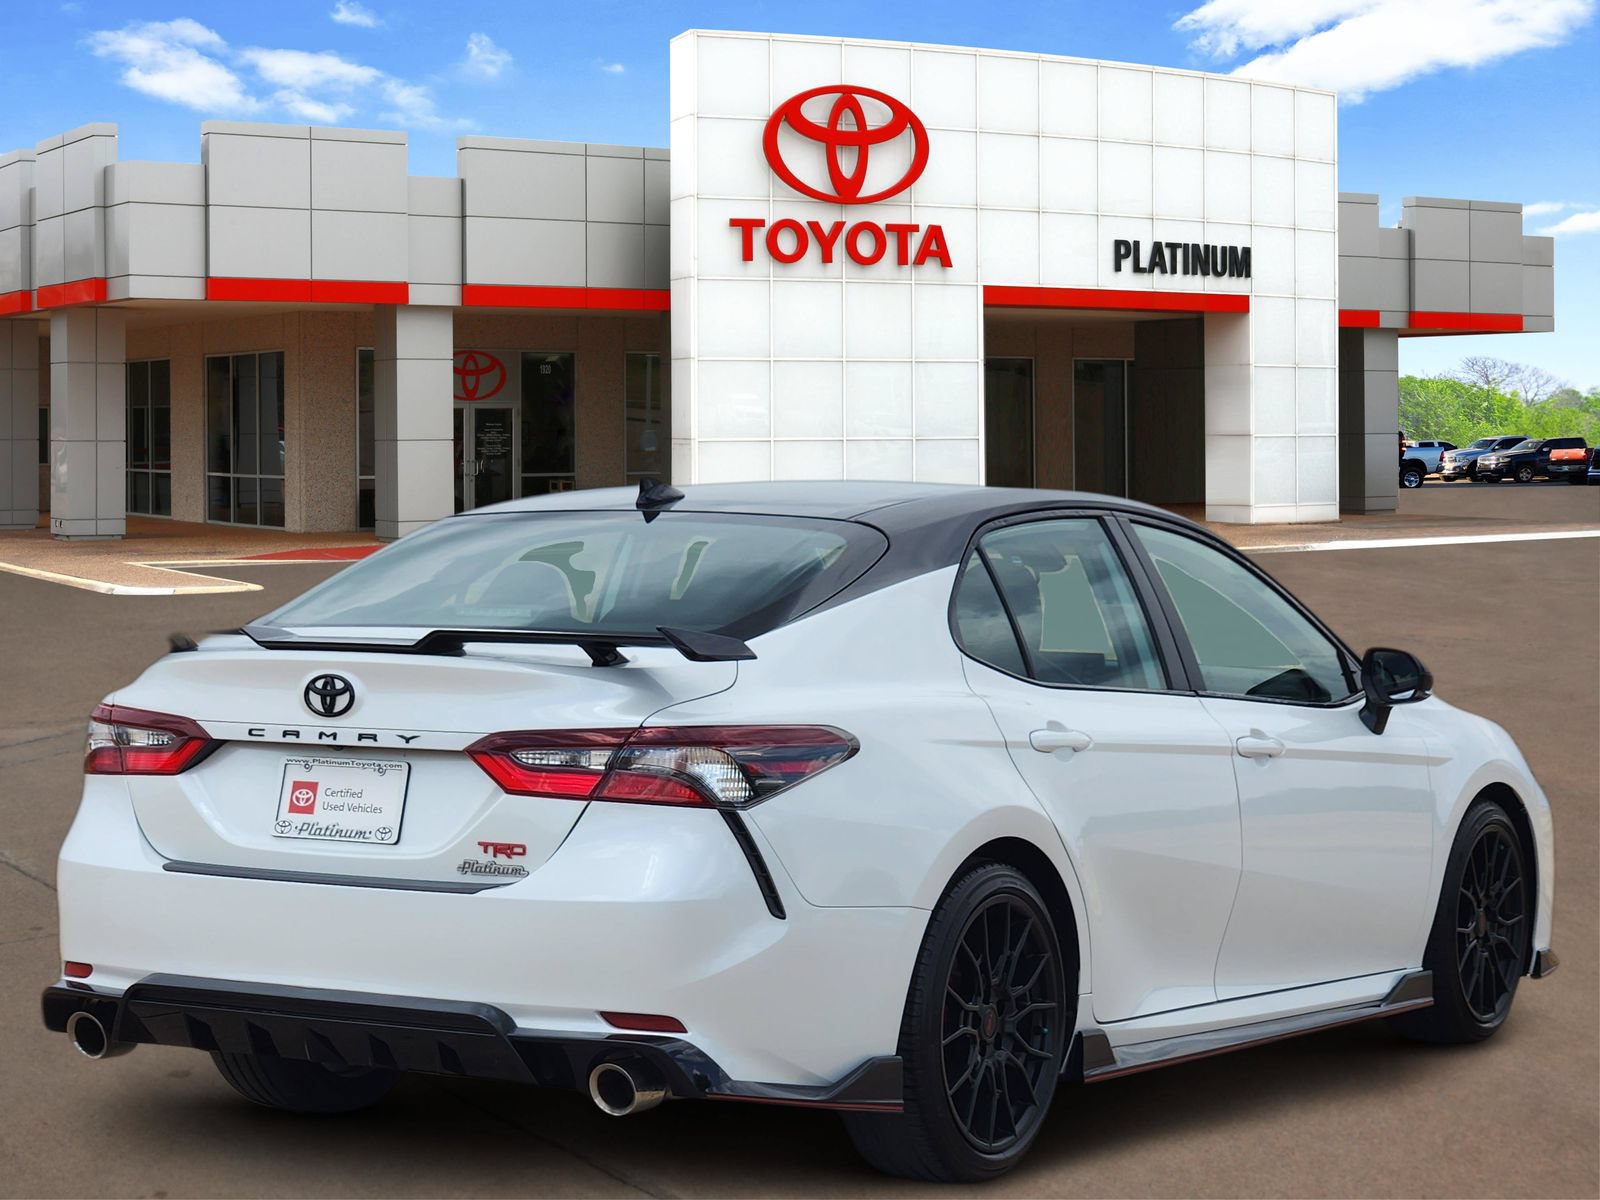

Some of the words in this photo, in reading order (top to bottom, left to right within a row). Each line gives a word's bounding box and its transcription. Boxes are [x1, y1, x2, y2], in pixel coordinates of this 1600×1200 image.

[729, 218, 953, 268] TOYOTA
[1114, 239, 1251, 278] PLATINUM
[248, 728, 421, 744] CAMRY
[286, 758, 403, 769] www.PlatinumToyota.com
[324, 787, 364, 799] Certified
[322, 801, 345, 812] Used
[347, 803, 383, 814] Vehicles
[298, 822, 372, 840] Platinum
[477, 841, 527, 859] TRD
[457, 858, 530, 878] Platinum
